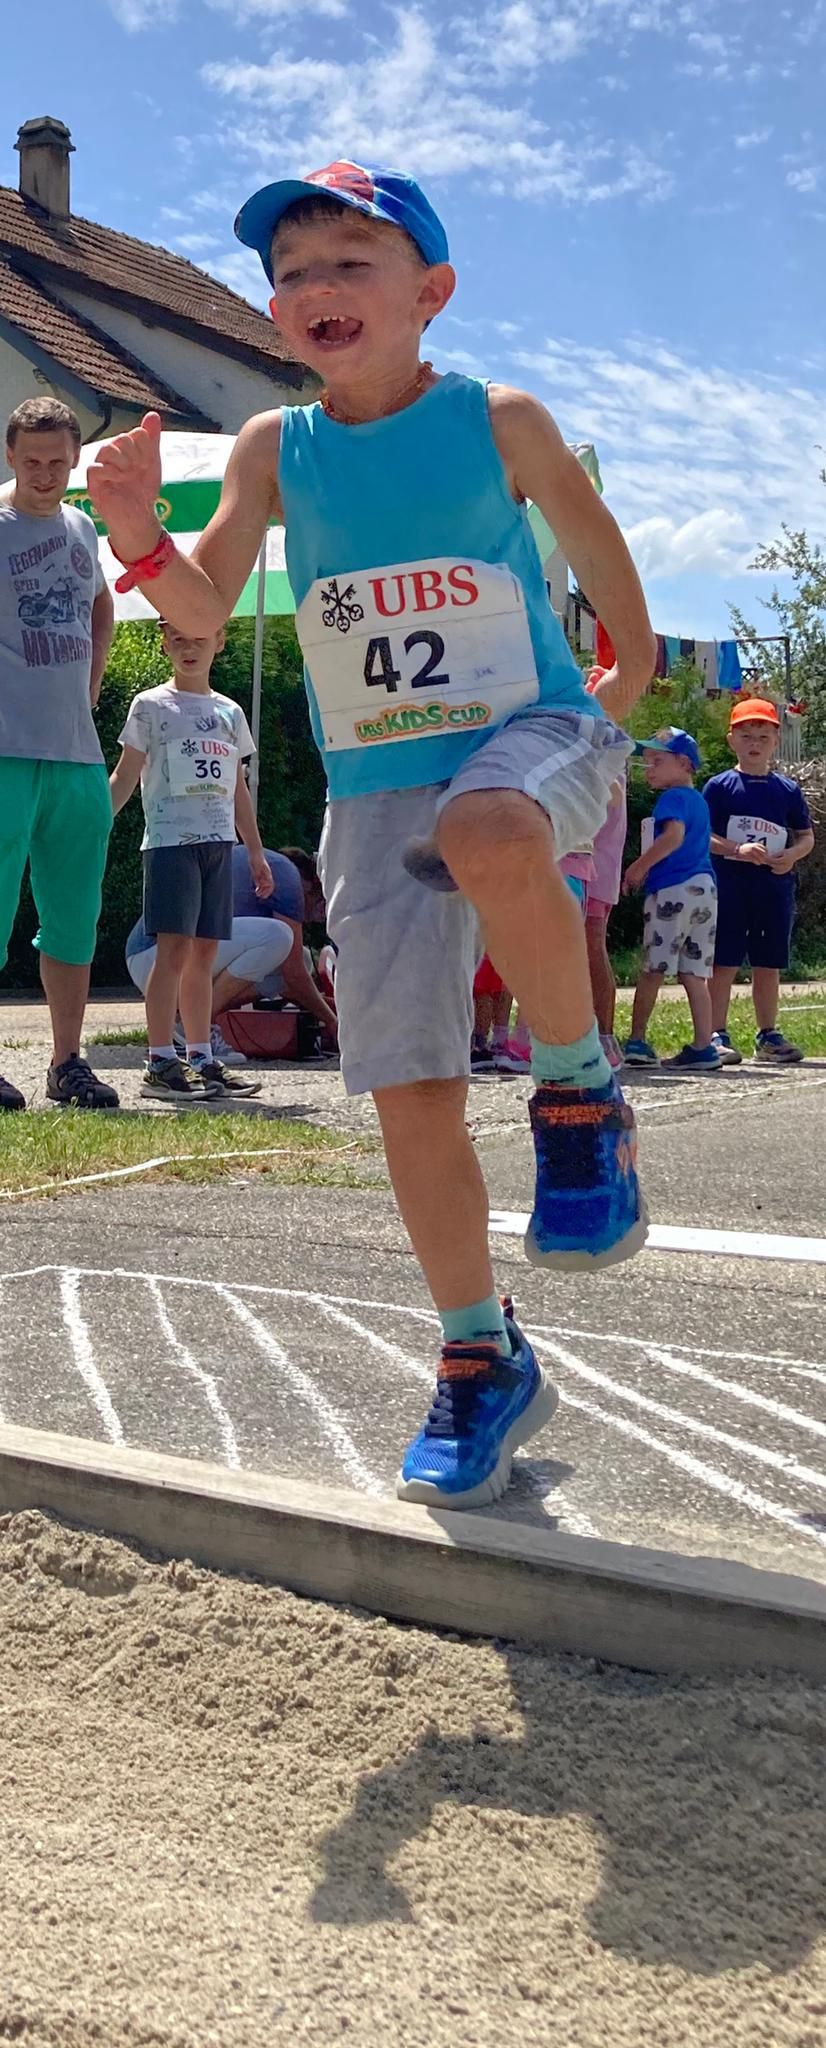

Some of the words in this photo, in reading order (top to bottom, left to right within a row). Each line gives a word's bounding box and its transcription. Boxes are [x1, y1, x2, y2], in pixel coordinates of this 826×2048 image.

[9, 535, 67, 576] LEGENDARY
[14, 578, 40, 594] SPEED
[368, 565, 479, 617] UBS
[363, 630, 450, 693] 42
[358, 722, 385, 737] UBS
[384, 705, 445, 733] KIDS
[447, 706, 487, 723] CUP
[201, 741, 230, 757] UBS
[194, 760, 221, 779] 36
[754, 819, 780, 835] UBS
